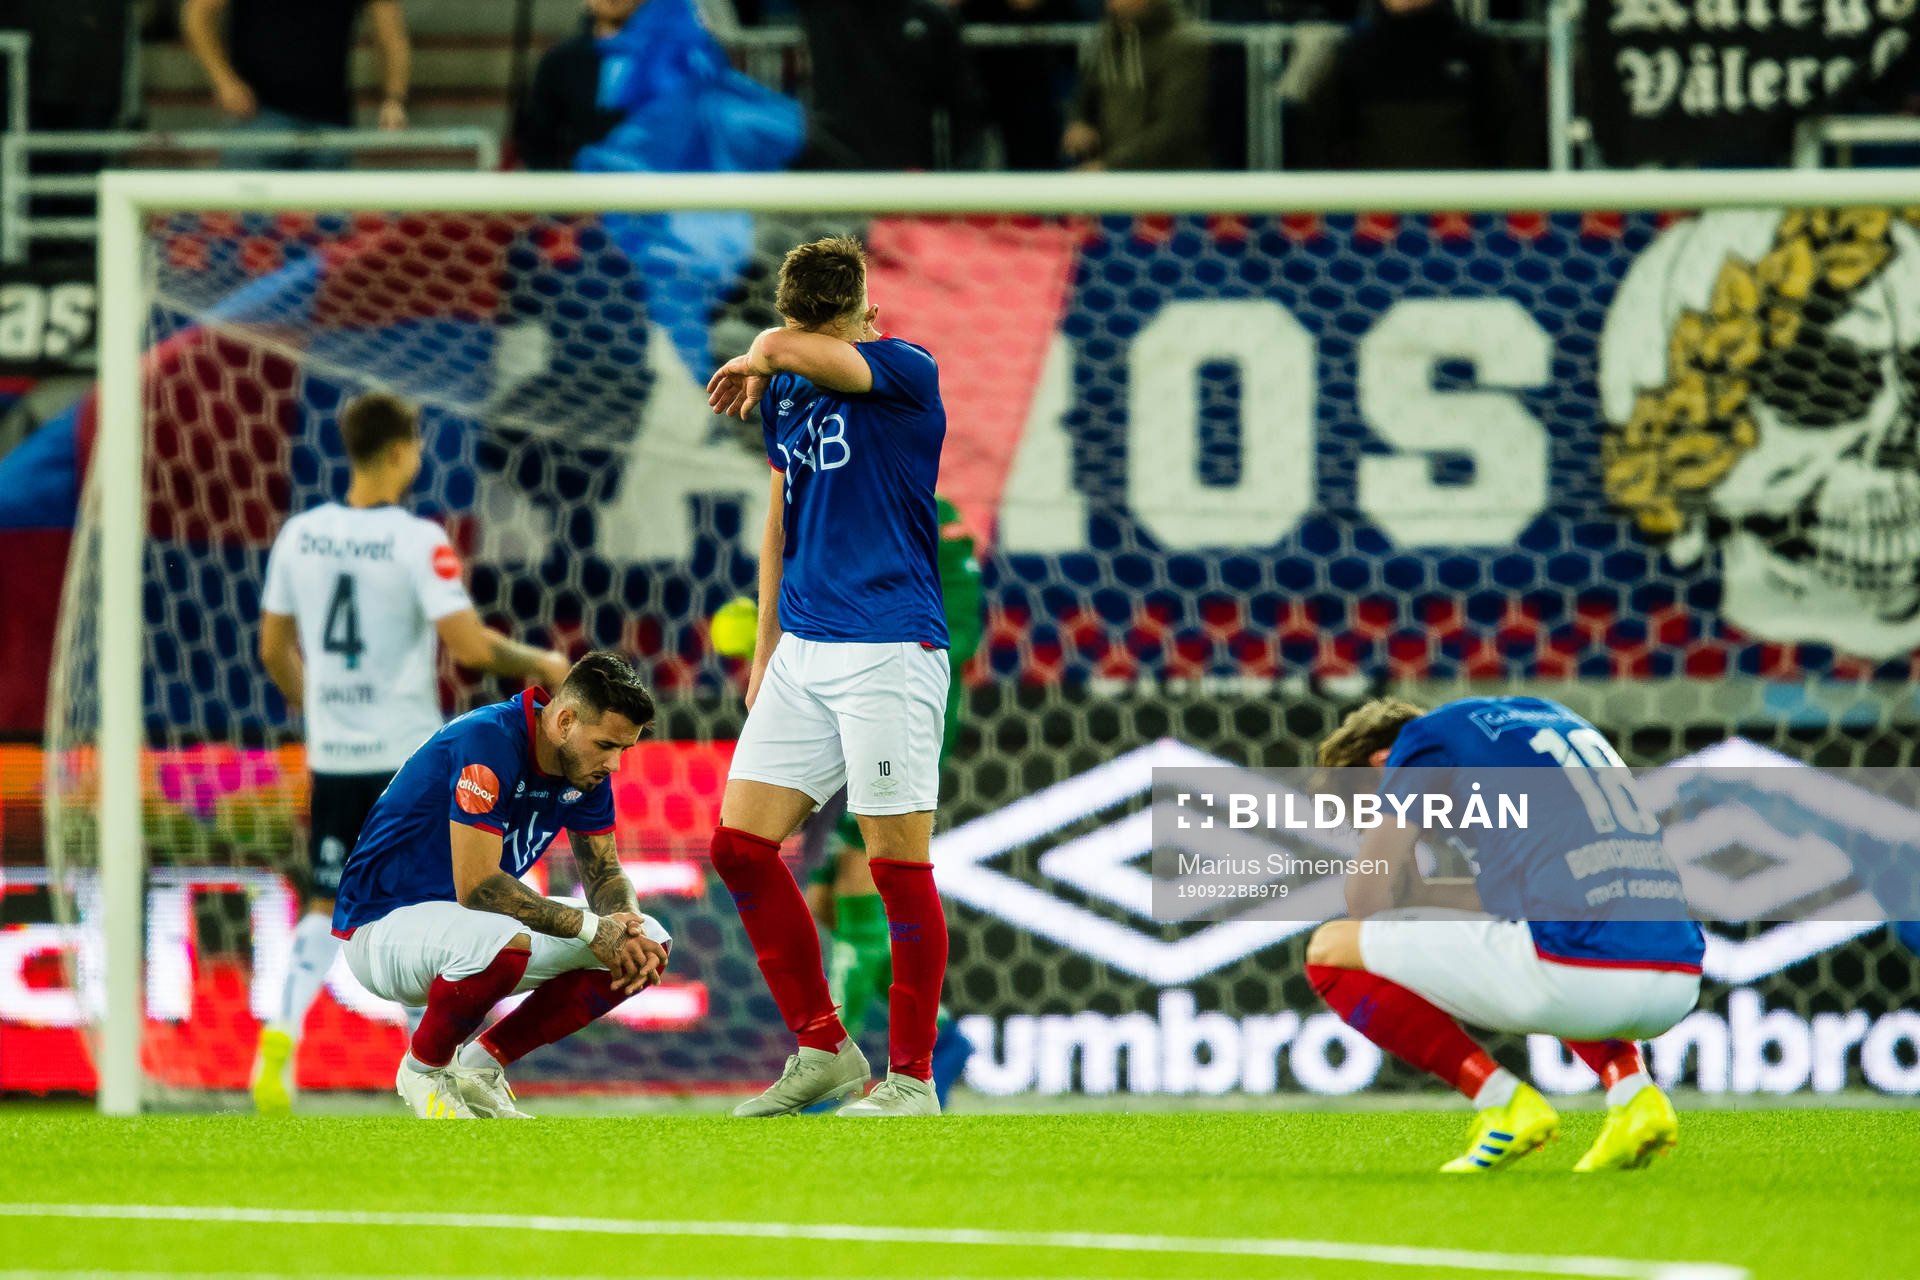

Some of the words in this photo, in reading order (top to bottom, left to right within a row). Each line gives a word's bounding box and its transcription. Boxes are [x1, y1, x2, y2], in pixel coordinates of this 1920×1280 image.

[322, 573, 367, 670] 4
[878, 761, 891, 776] 10
[1529, 727, 1661, 835] 18
[960, 989, 1383, 1096] umbro
